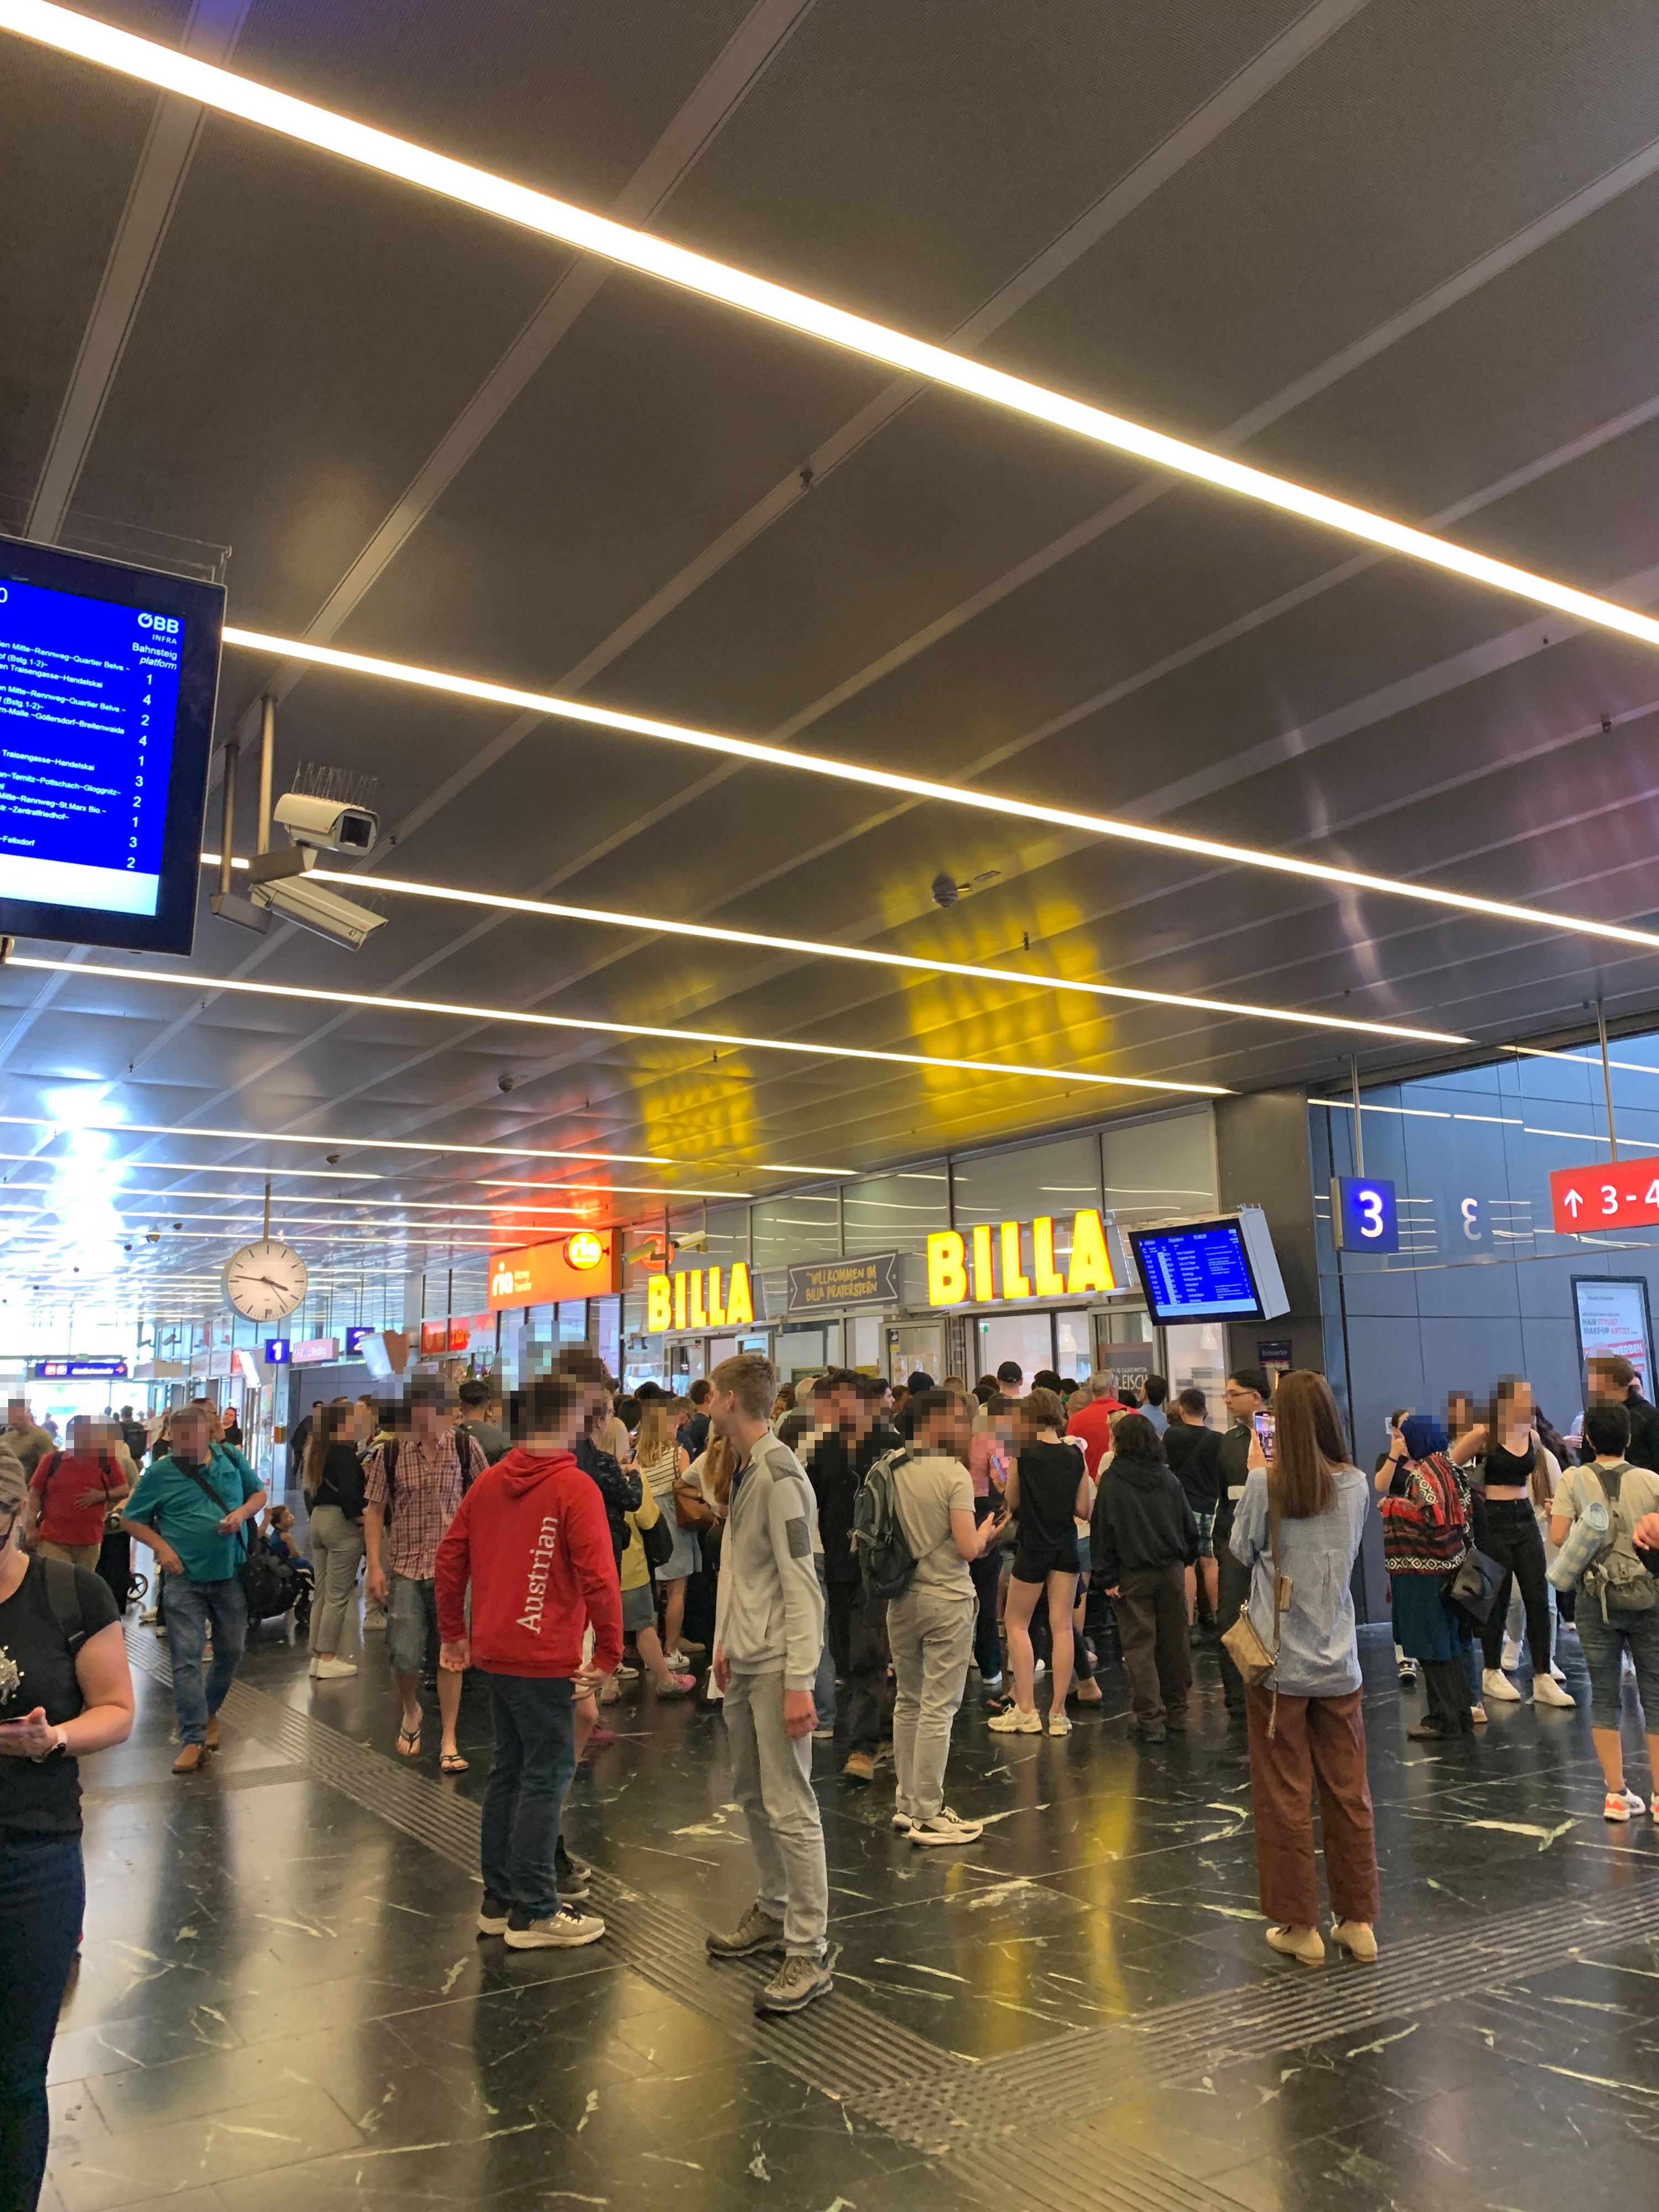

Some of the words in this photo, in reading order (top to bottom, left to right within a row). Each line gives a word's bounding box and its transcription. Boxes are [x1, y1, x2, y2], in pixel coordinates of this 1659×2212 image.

[138, 613, 179, 634] ÖBB
[153, 634, 177, 645] INFRA
[132, 642, 178, 661] Bahnsteig
[139, 656, 177, 670] platform
[147, 674, 152, 685] 1
[143, 694, 152, 706] 4
[140, 714, 150, 726] 2
[138, 735, 147, 747] 4
[138, 755, 144, 766] 1
[134, 775, 144, 787] 3
[133, 796, 142, 808] 2
[132, 816, 138, 828] 1
[129, 836, 138, 848] 3
[127, 857, 135, 869] 2
[1358, 1190, 1384, 1238] 3
[571, 1236, 600, 1257] ria
[927, 1209, 1115, 1306] BILLA
[492, 1261, 513, 1297] ria
[806, 1267, 864, 1285] WILLKOMMEN
[867, 1264, 877, 1279] IM
[648, 1262, 754, 1332] BILLA
[805, 1287, 825, 1302] BILLA
[827, 1280, 878, 1300] PRATERSTERN
[1610, 1327, 1630, 1335] ARTIST
[272, 1342, 283, 1360] 1
[516, 1516, 559, 1635] Austrian
